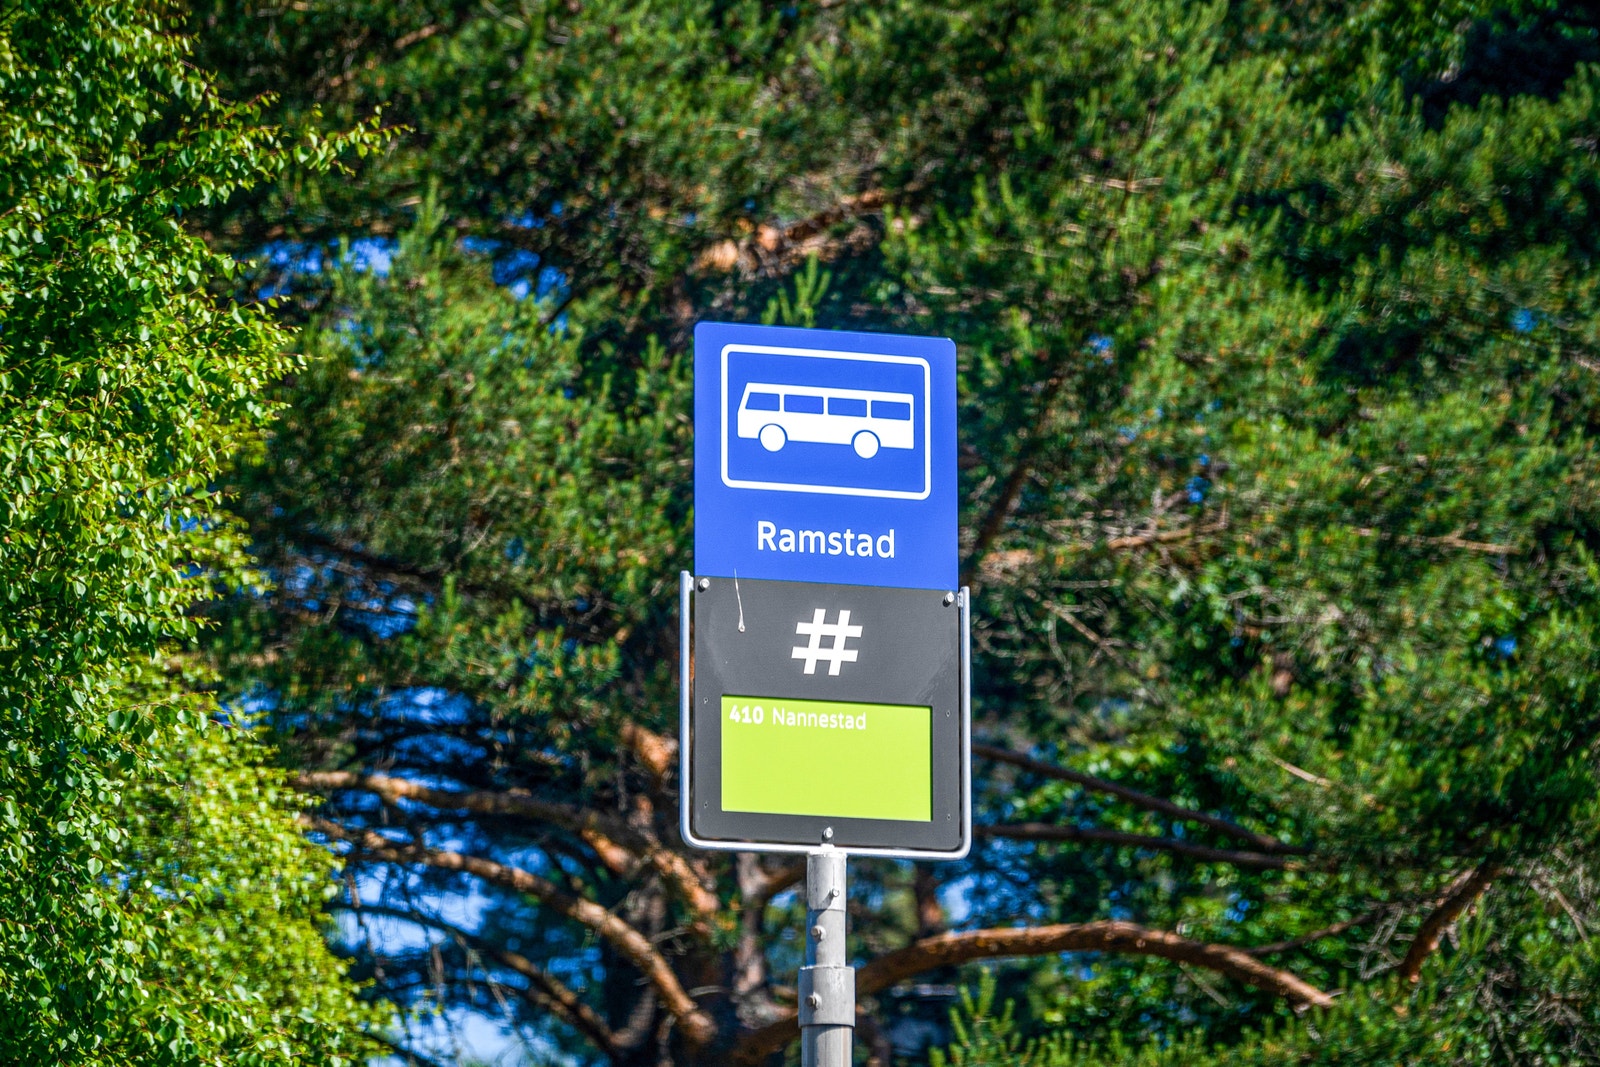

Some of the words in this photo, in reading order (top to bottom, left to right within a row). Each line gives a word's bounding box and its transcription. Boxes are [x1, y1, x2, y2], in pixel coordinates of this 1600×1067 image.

[757, 520, 895, 559] Ramstad
[728, 704, 765, 725] 410
[771, 706, 867, 731] Nannestad
